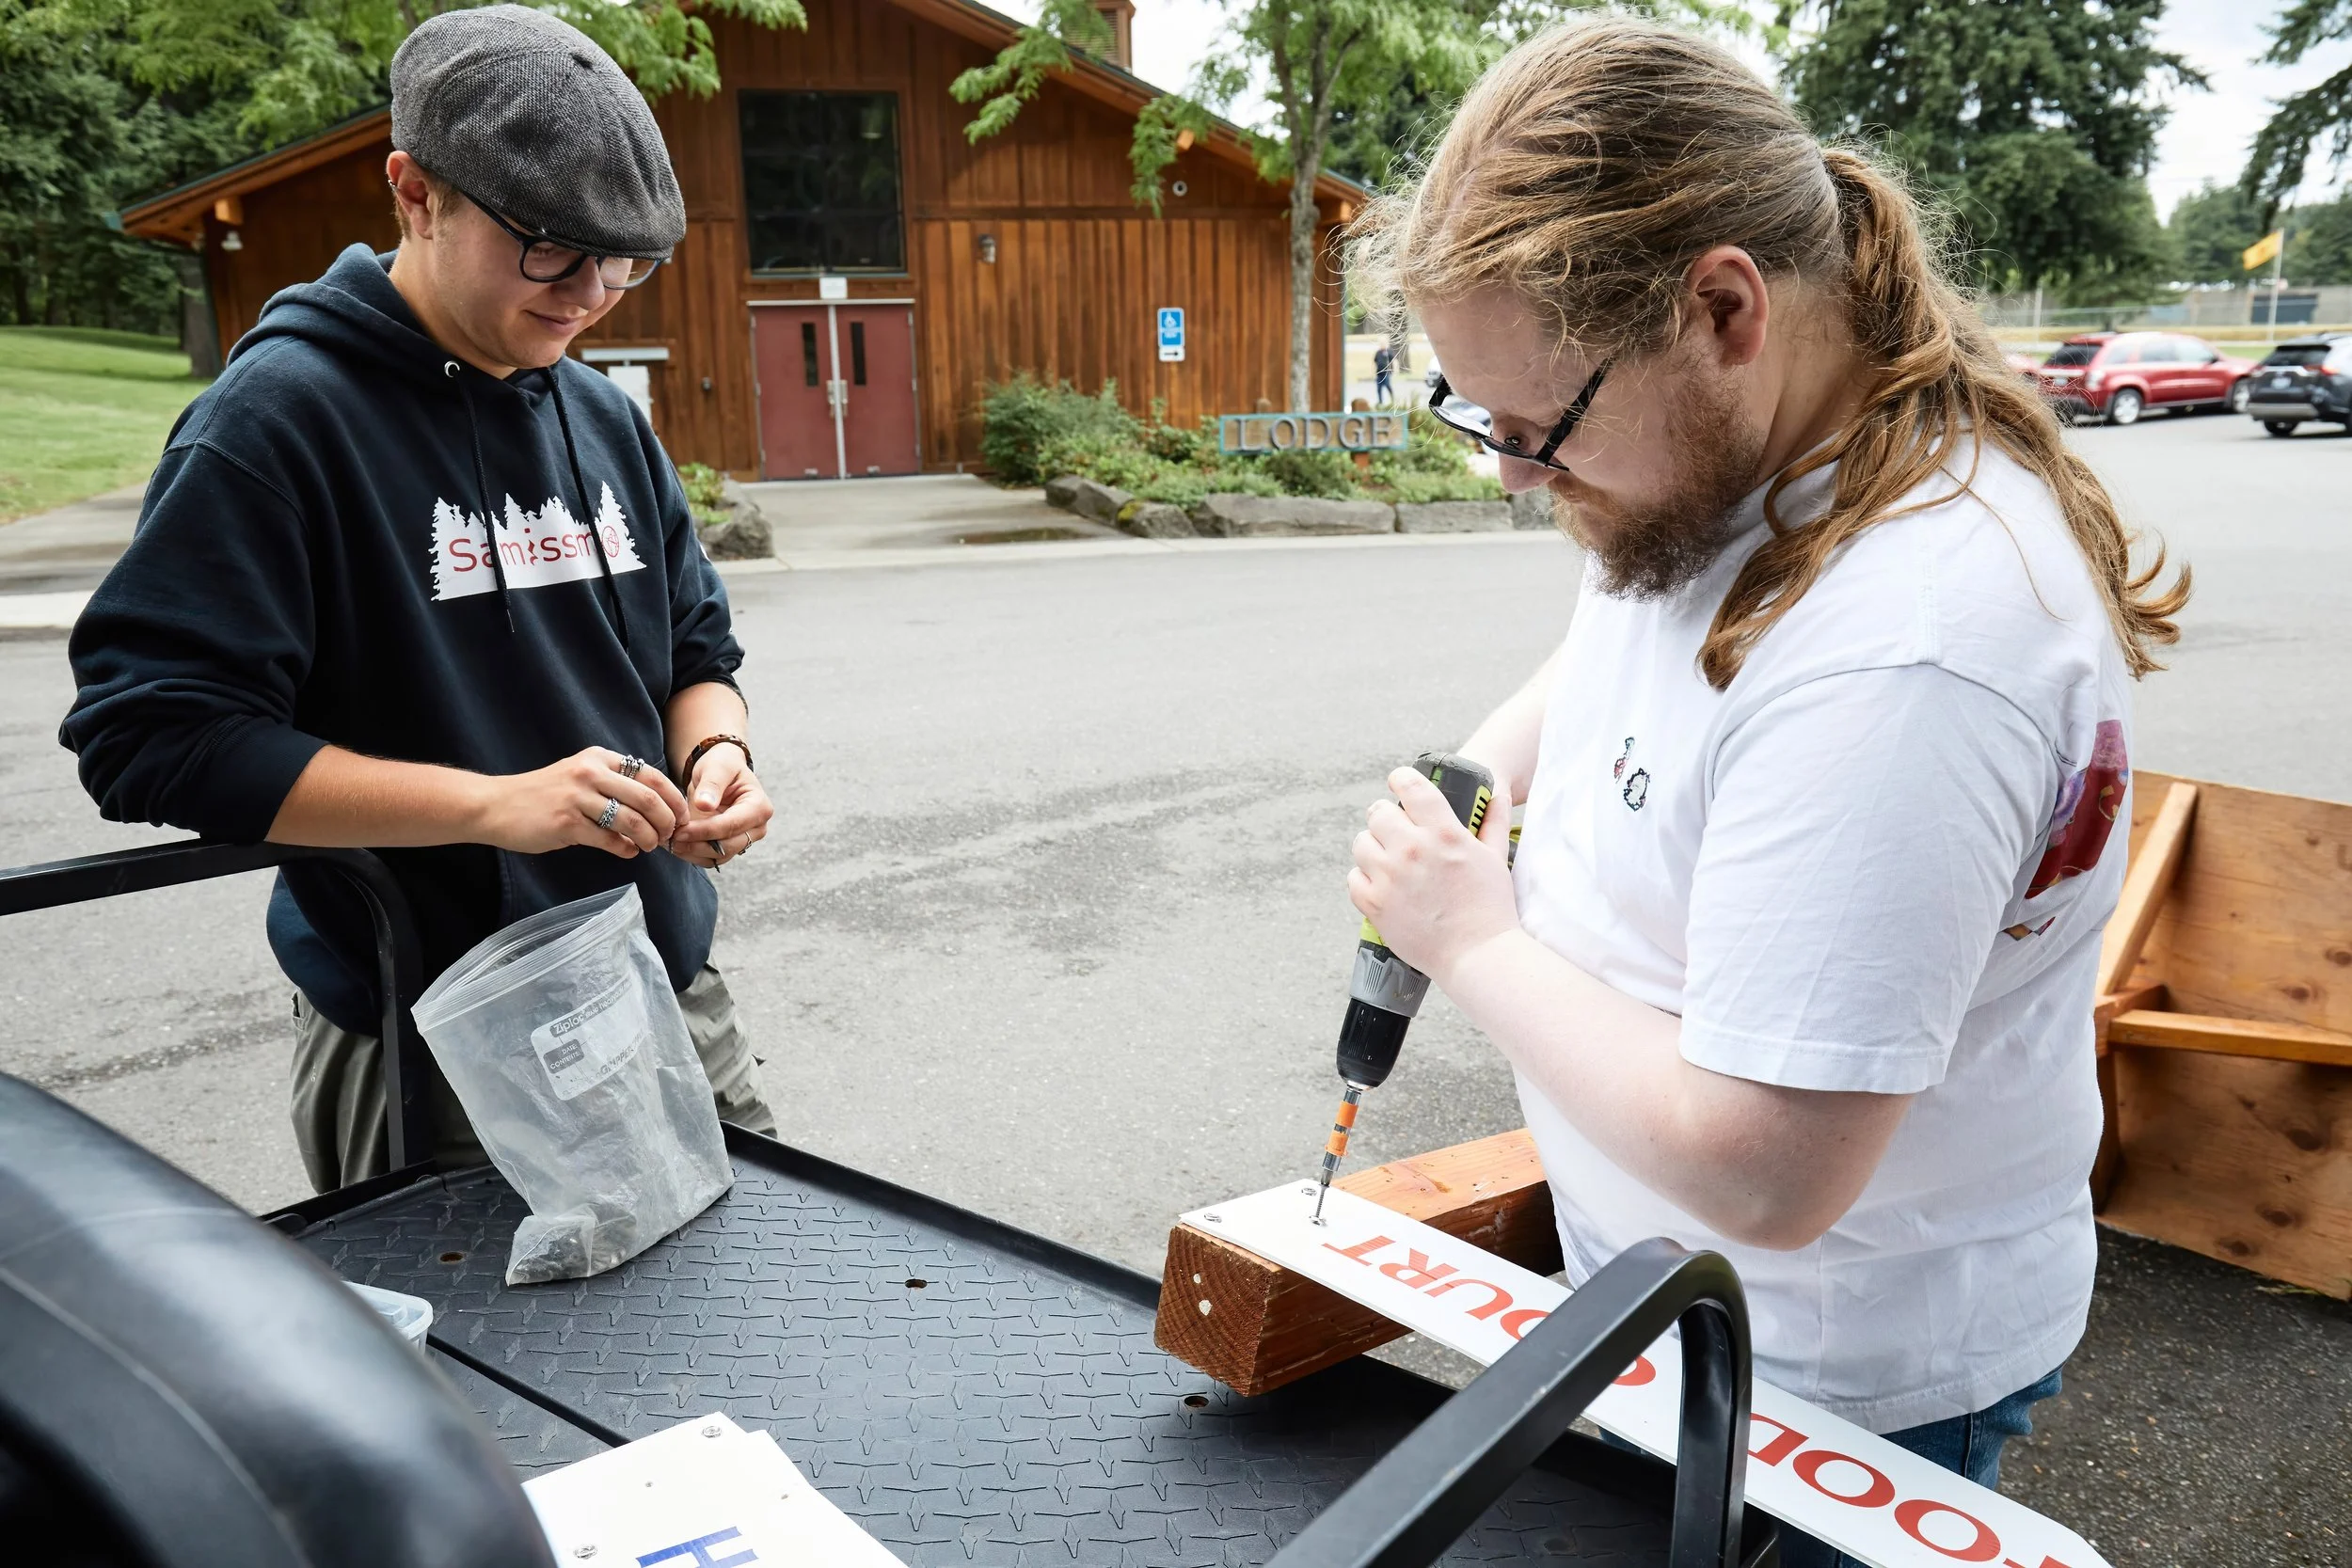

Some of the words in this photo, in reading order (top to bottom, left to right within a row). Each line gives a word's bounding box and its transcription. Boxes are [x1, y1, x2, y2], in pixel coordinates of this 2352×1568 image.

[1237, 416, 1392, 451] LODGE
[553, 1013, 584, 1035] Ziploc
[1747, 1411, 2073, 1568] OOD
